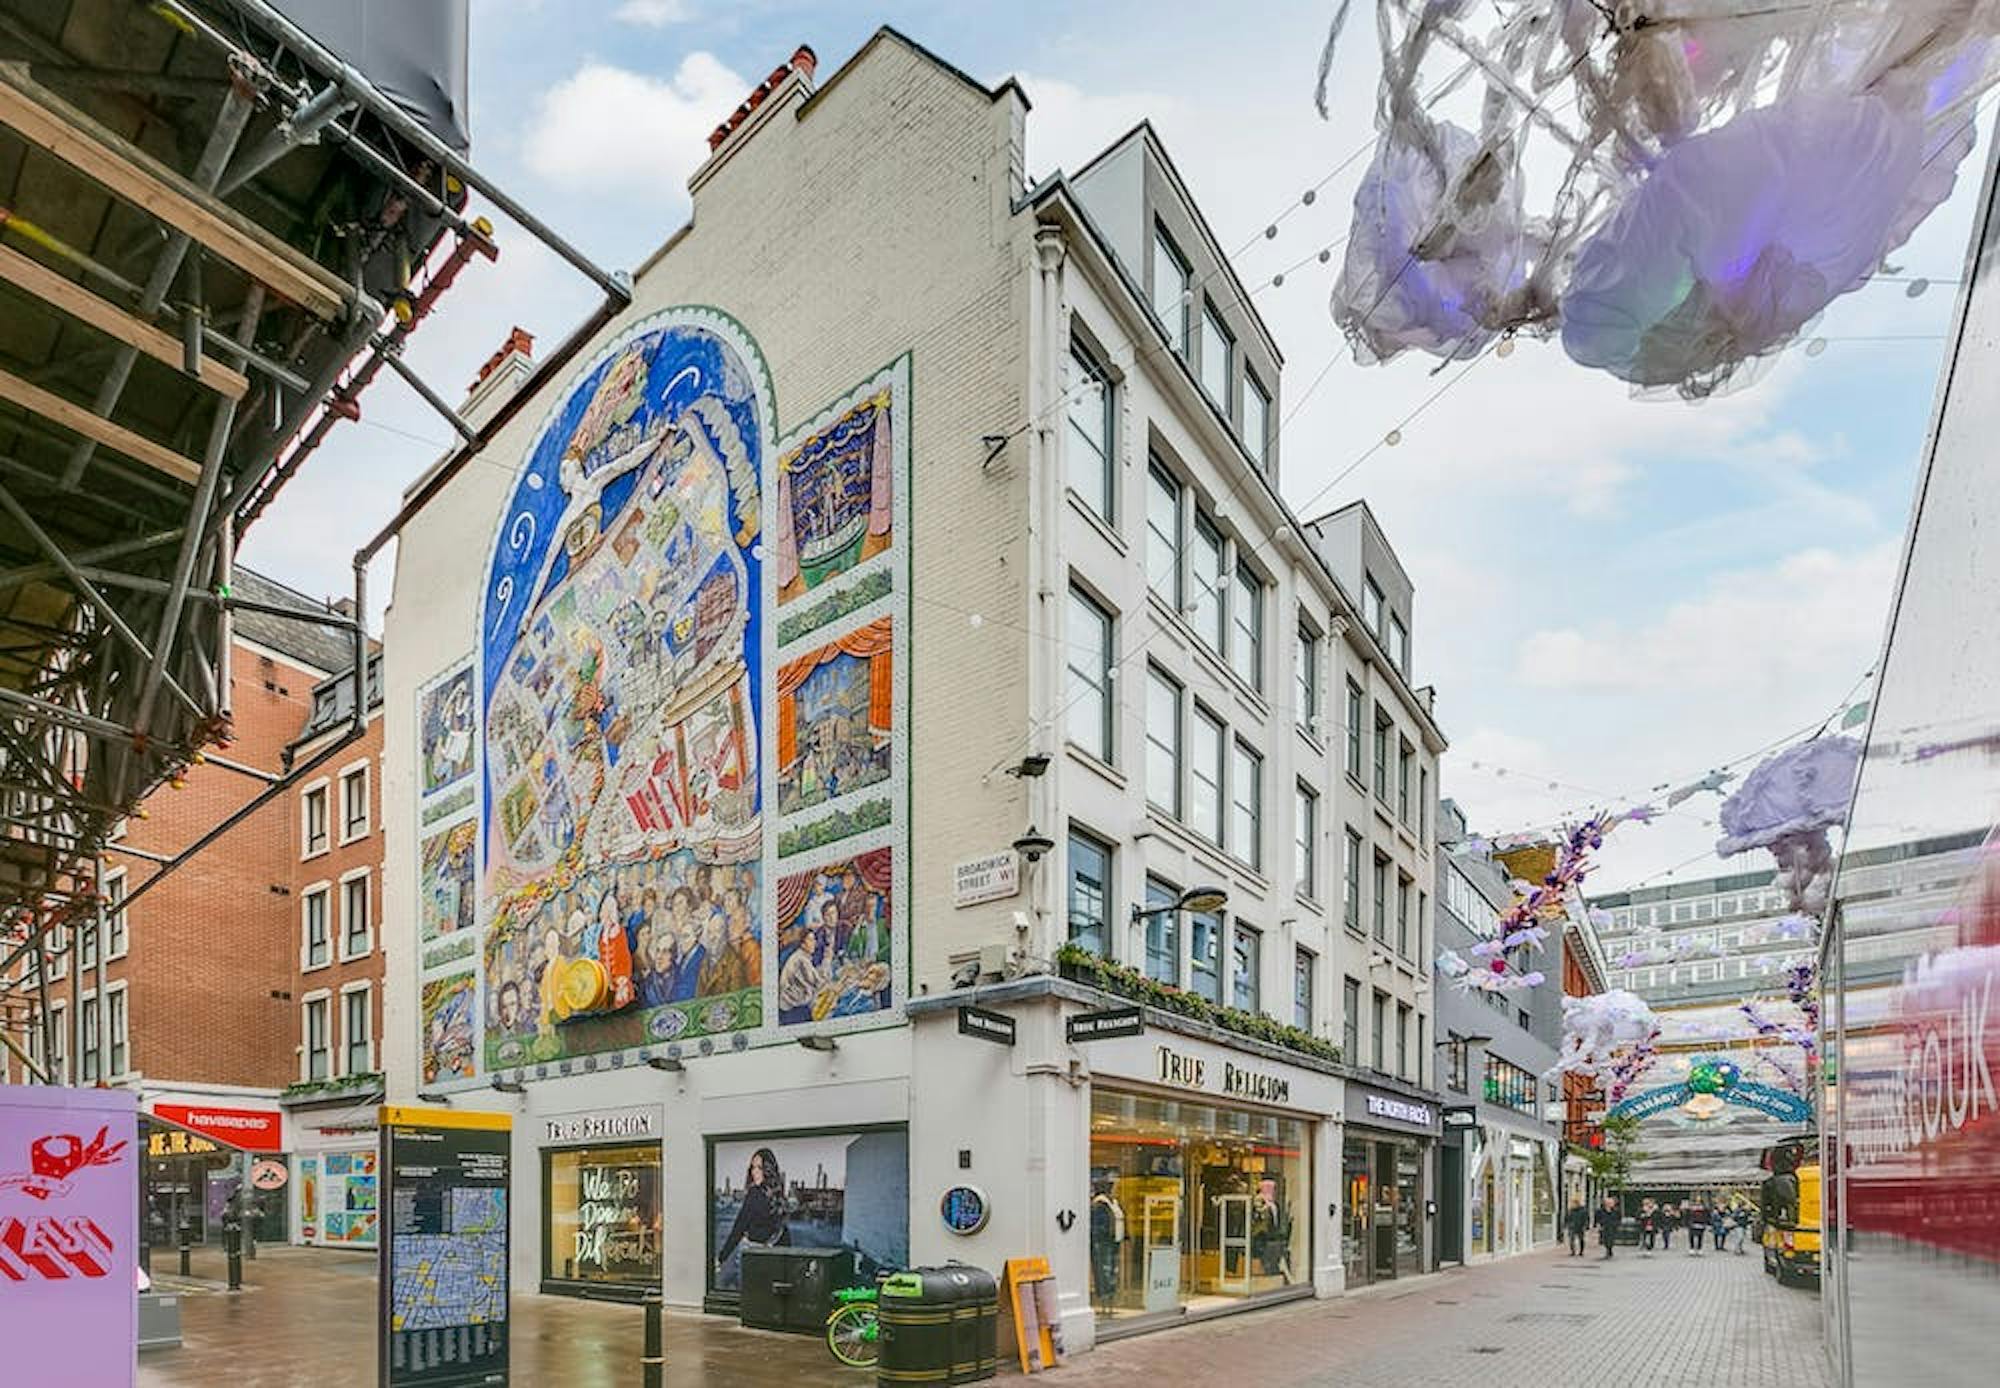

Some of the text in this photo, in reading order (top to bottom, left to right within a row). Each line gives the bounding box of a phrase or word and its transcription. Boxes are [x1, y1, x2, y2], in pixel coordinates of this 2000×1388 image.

[957, 854, 1010, 879] BROADWICK
[957, 872, 991, 891] STREET
[1157, 1045, 1290, 1102] TRUE RELIGION
[583, 1114, 652, 1138] RELIGION
[582, 1168, 612, 1200] We
